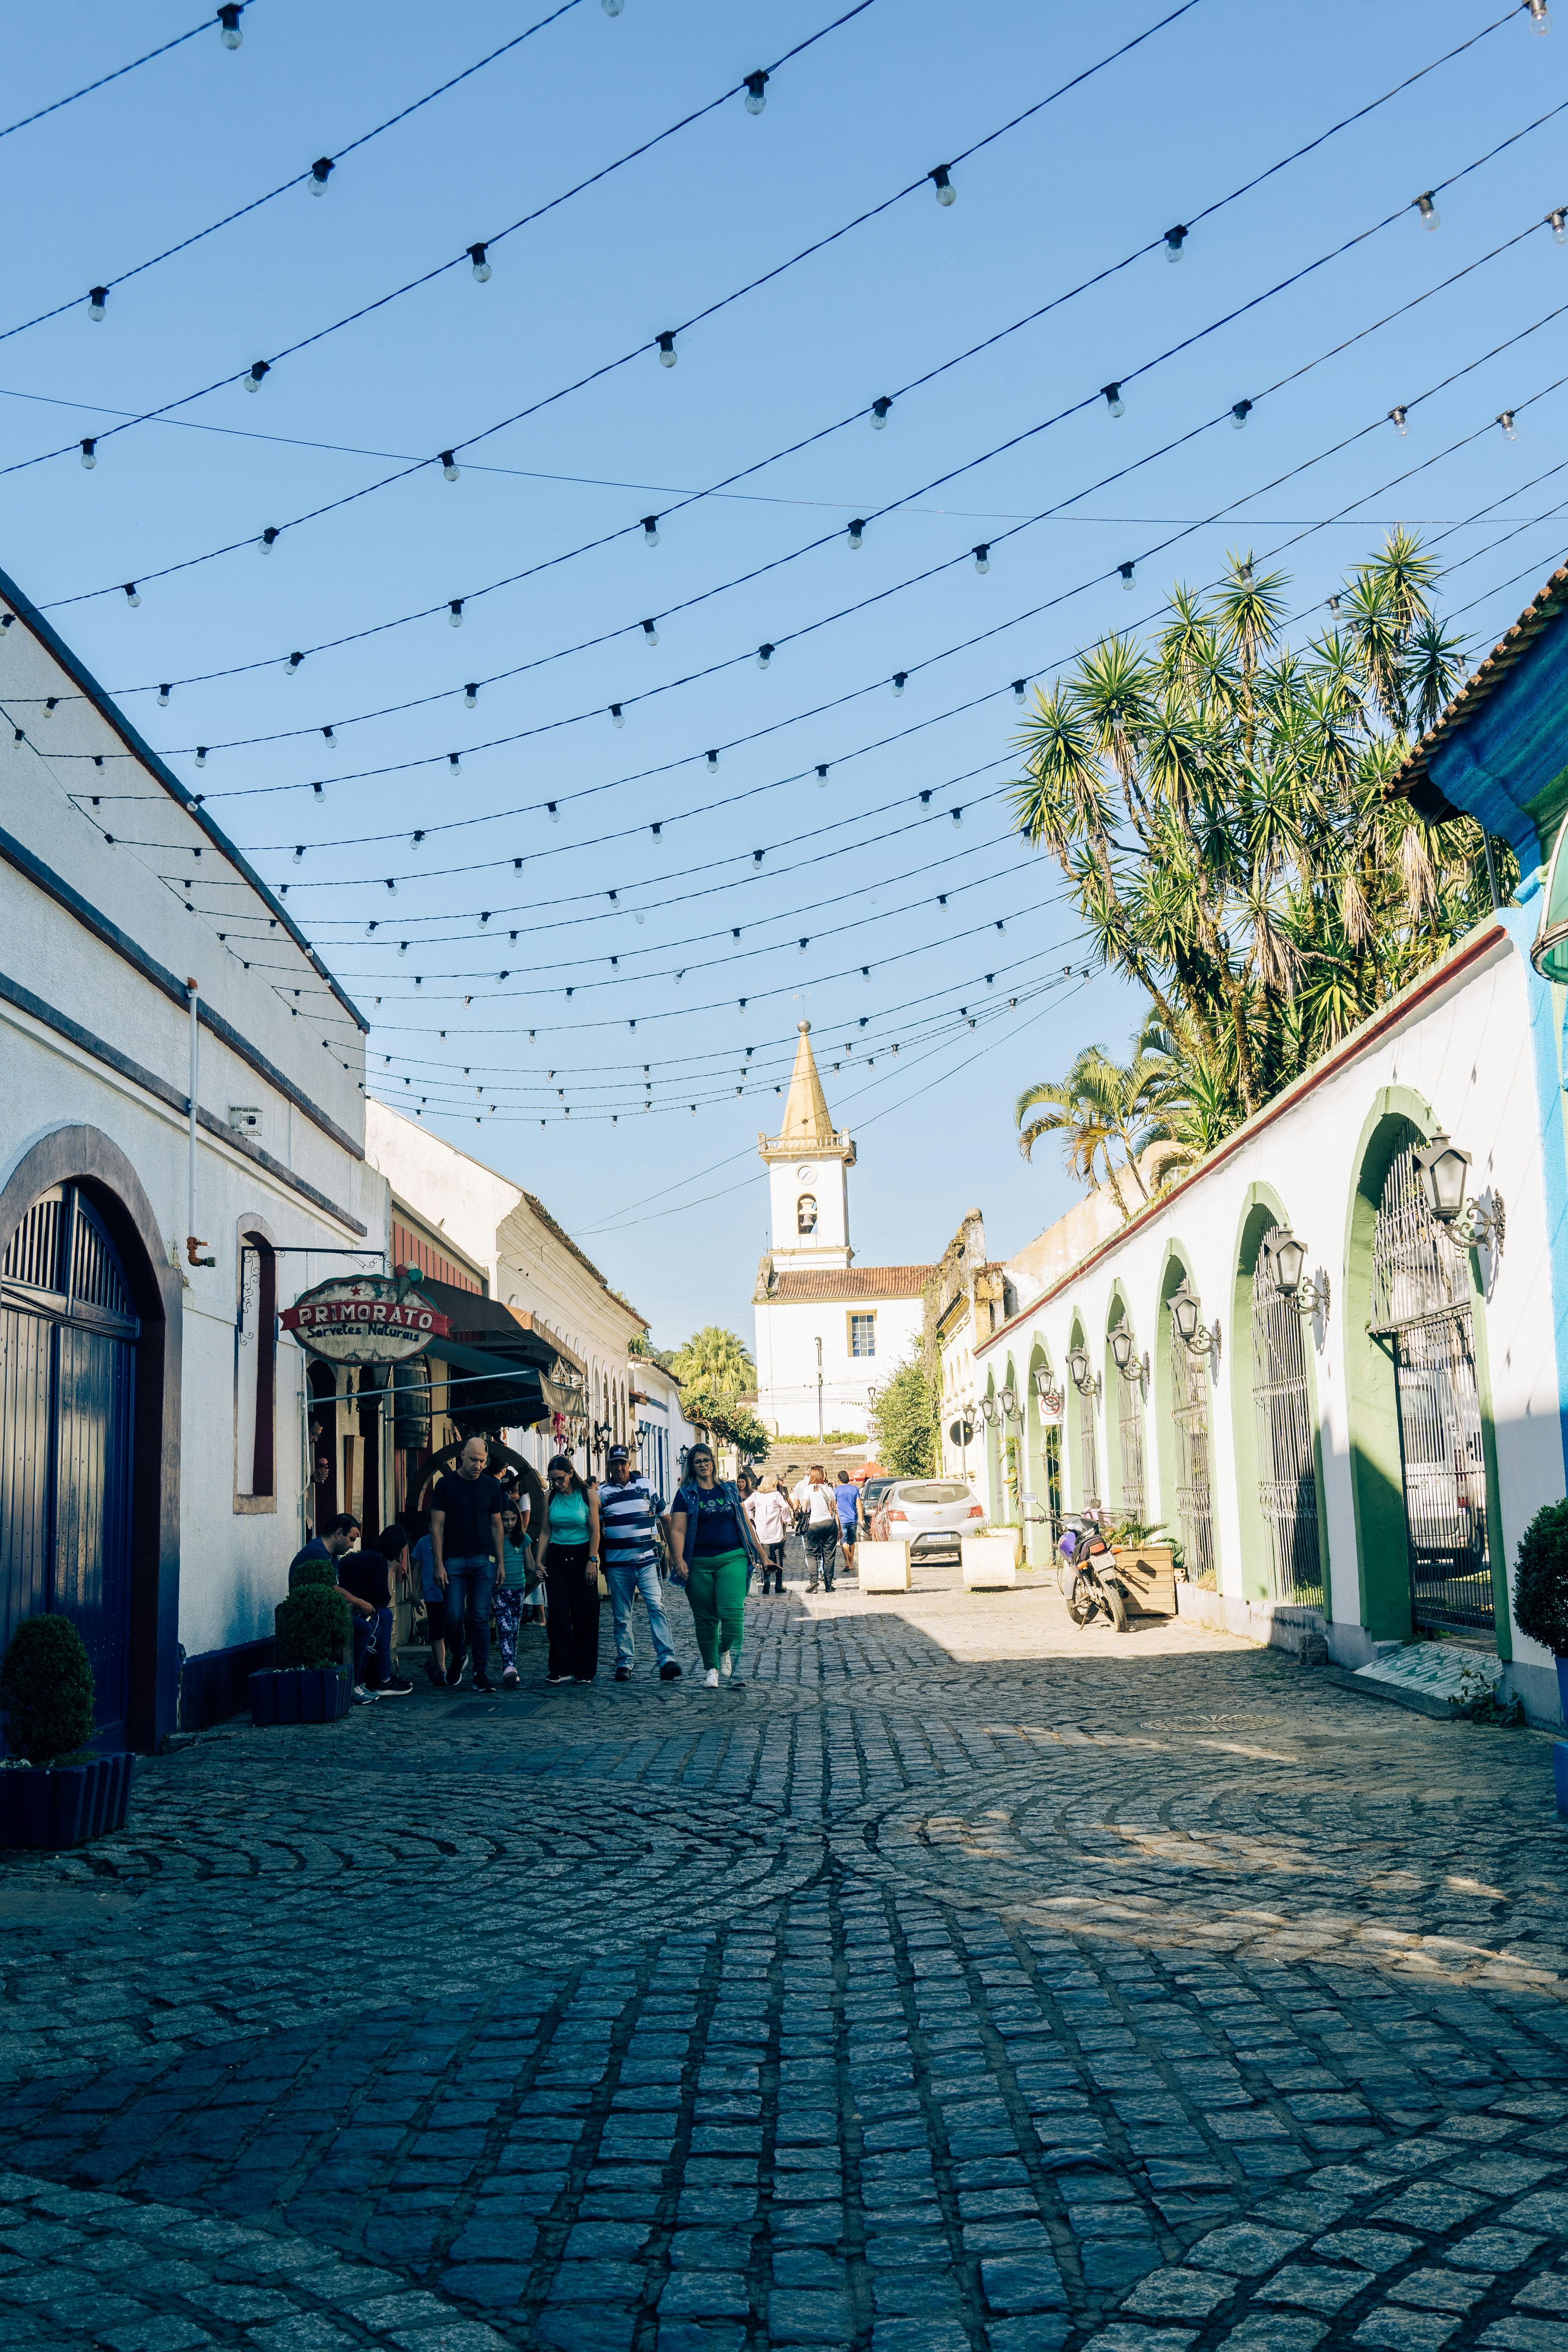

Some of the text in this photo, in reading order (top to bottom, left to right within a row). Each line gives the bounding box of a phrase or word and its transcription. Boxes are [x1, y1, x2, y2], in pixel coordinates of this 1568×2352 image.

[298, 1304, 432, 1329] PRIMORATO
[307, 1322, 420, 1342] Sorvetes Naturais
[1422, 1465, 1438, 1474] 15
